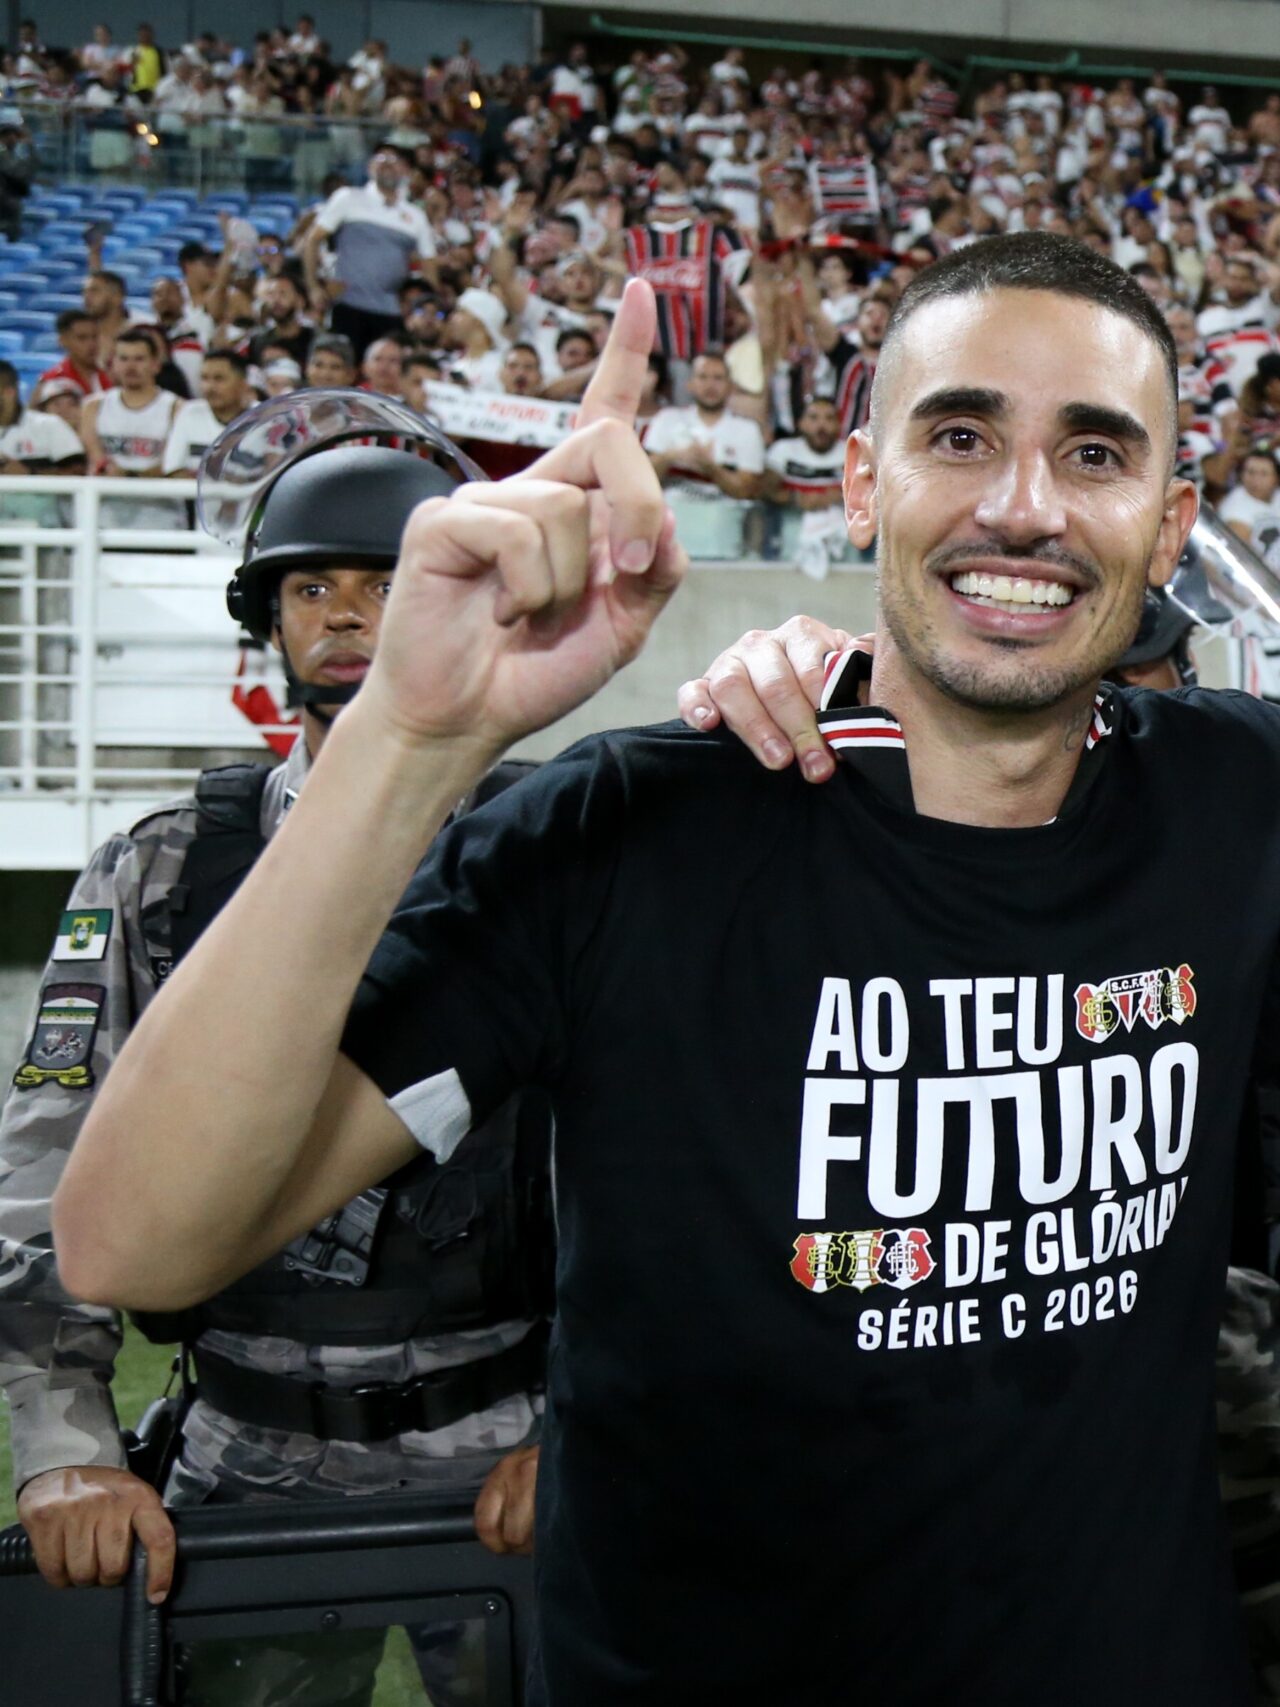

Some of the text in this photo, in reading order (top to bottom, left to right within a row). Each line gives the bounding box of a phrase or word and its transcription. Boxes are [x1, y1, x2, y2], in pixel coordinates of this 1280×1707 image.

[806, 973, 1065, 1073] AO TEU
[796, 1041, 1200, 1220] FUTURO
[944, 1219, 1012, 1289] DE
[857, 1269, 1138, 1351] SÉRIE C 2026
